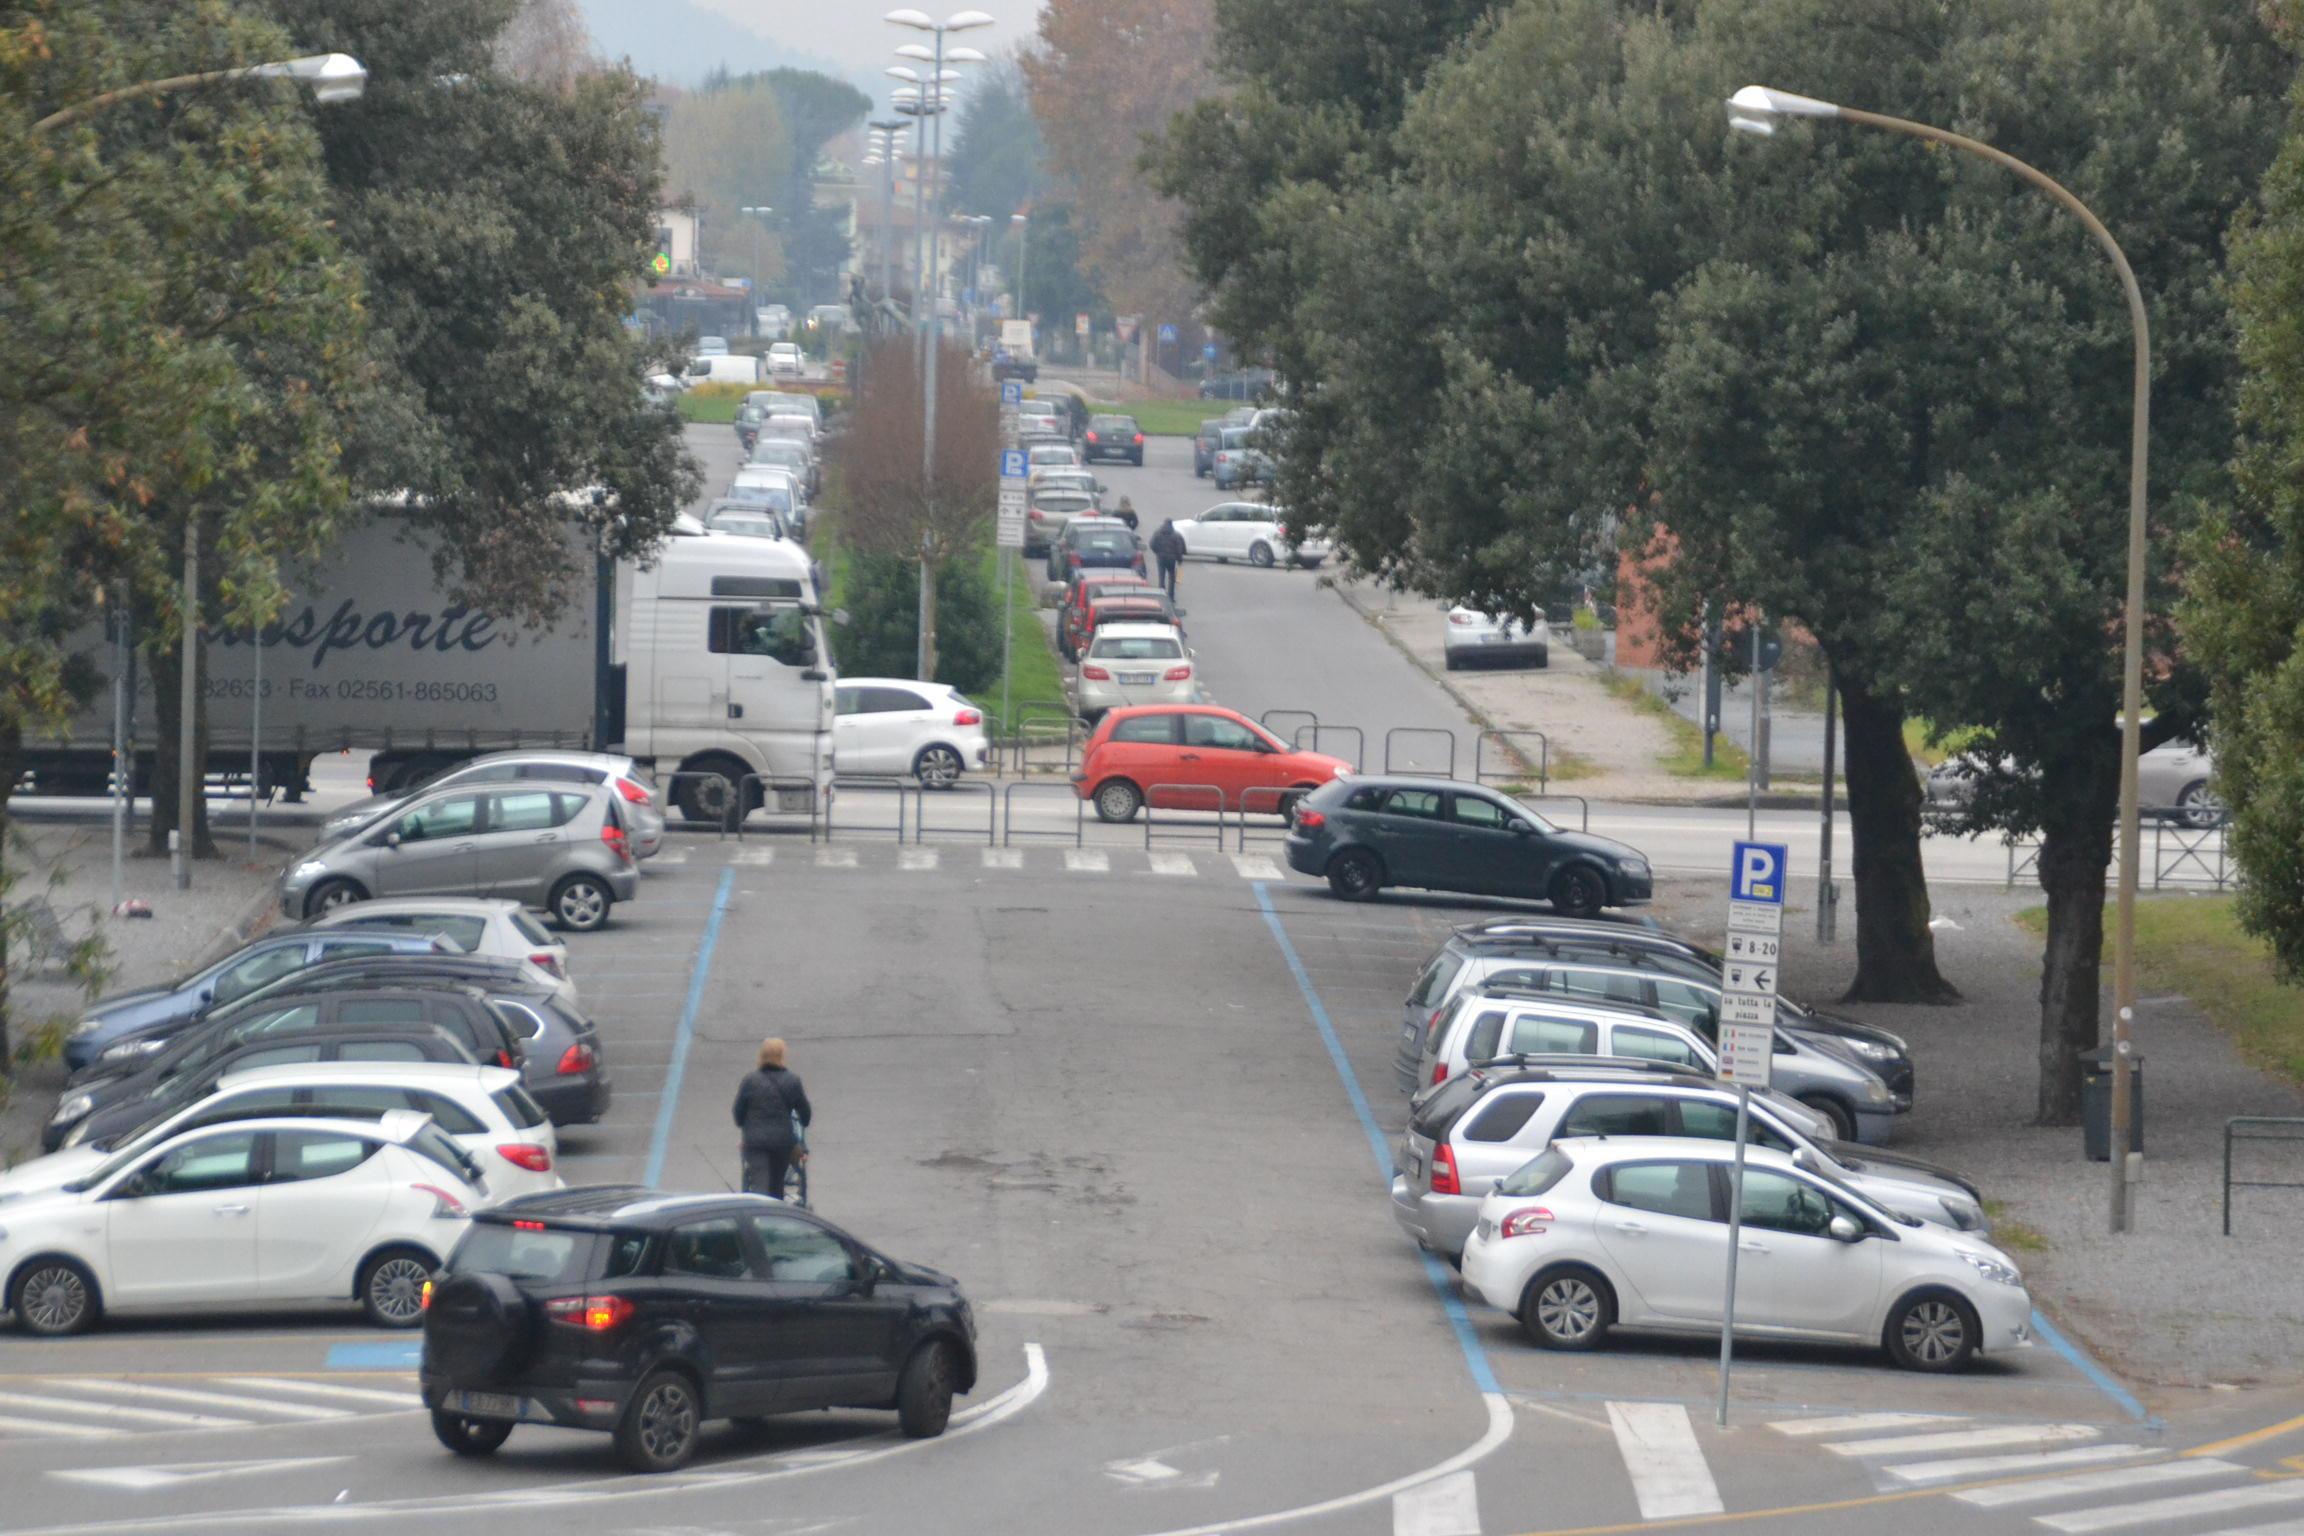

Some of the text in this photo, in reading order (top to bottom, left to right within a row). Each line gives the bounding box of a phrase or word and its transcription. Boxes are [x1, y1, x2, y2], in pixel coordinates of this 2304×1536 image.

[1006, 450, 1024, 475] P
[289, 678, 329, 699] Fax
[337, 679, 497, 702] 02561-865063
[1741, 847, 1775, 896] P
[1737, 997, 1758, 1007] tutta
[1763, 998, 1771, 1008] la
[1735, 1011, 1758, 1020] piazza
